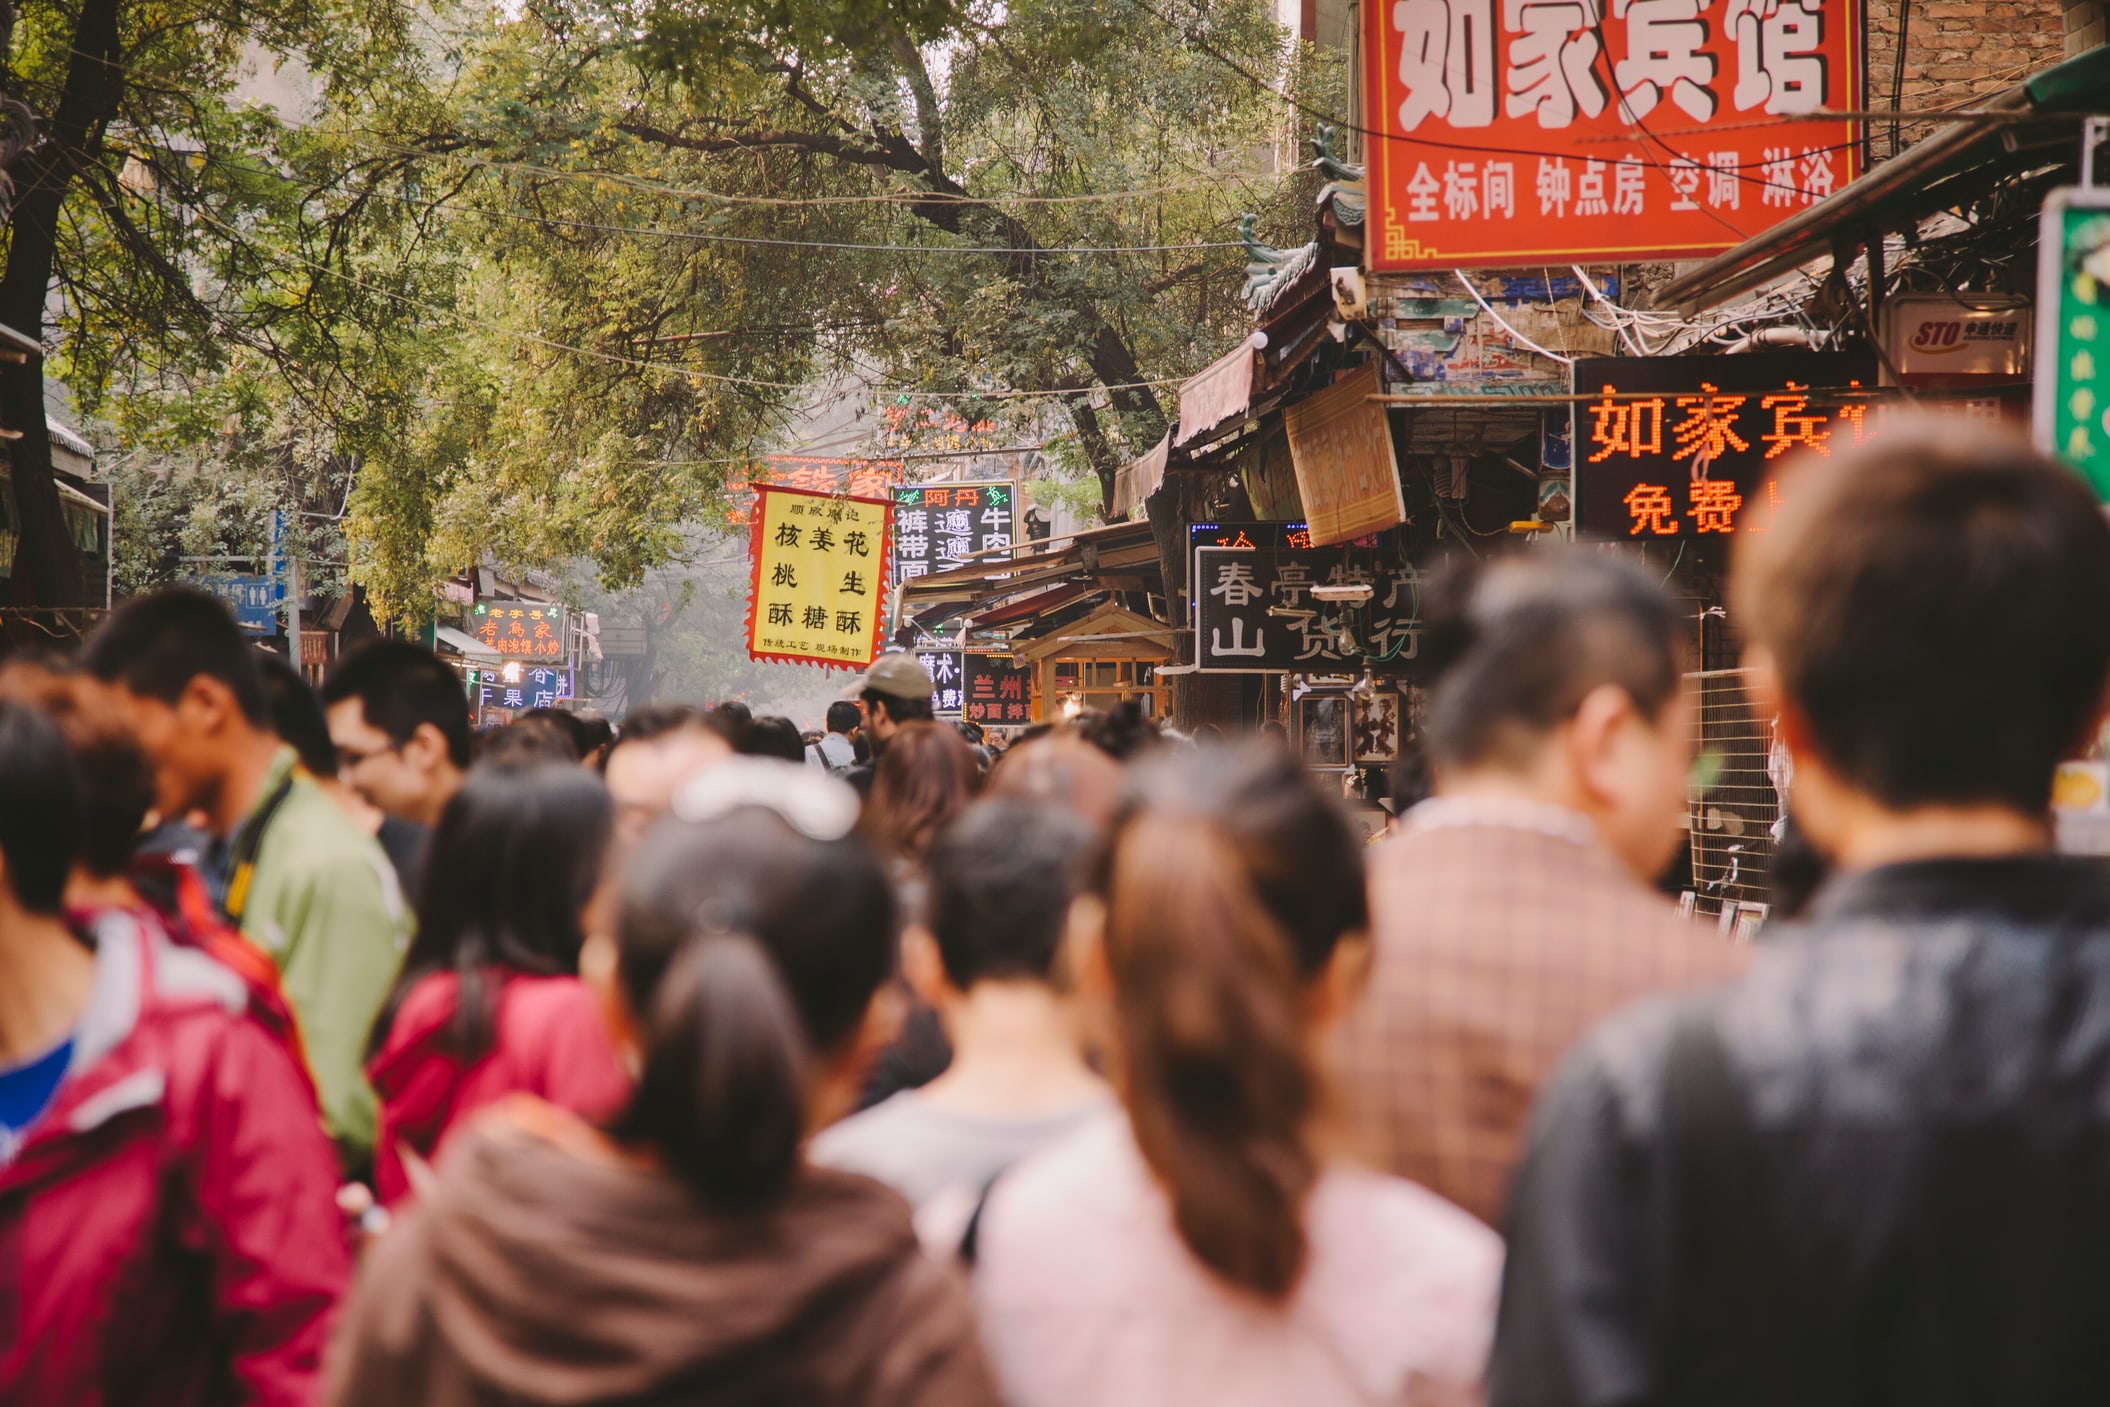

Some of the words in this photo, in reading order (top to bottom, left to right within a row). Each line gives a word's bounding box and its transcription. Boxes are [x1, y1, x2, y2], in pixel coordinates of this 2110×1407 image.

[1393, 0, 1828, 131] 如家宾馆
[1406, 158, 1516, 222] 全标间
[1536, 154, 1646, 218] 钟点房
[1669, 151, 1740, 211] 空调
[1762, 146, 1836, 208] 淋浴
[1915, 321, 1961, 345] STO
[924, 488, 979, 507] 阿丹
[489, 607, 544, 620] 老字号
[768, 522, 802, 627] 核桃酥
[801, 526, 835, 629] 姜糖
[836, 531, 869, 635] 花生酥
